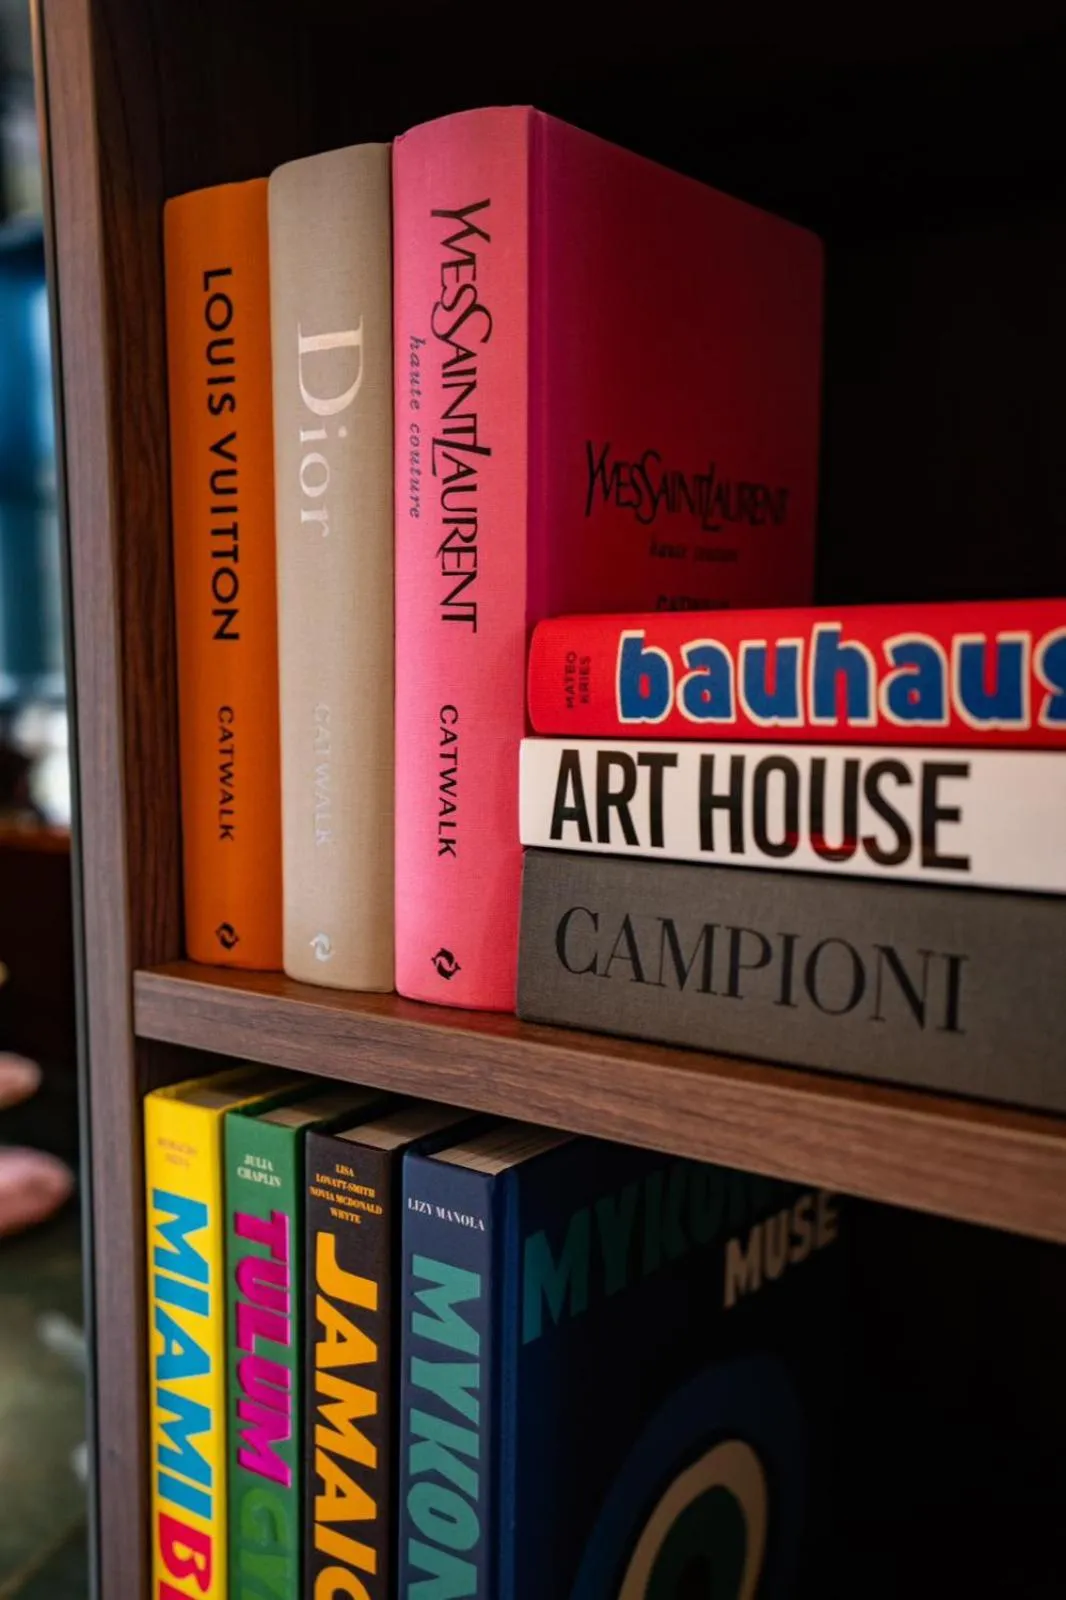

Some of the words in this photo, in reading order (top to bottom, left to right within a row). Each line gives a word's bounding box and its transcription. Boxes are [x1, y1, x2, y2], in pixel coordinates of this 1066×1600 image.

[203, 266, 235, 416] LOUIS
[409, 335, 426, 411] haute
[297, 314, 364, 538] Dior
[409, 422, 422, 519] couture
[209, 432, 240, 641] VUITTON
[565, 651, 577, 709] MATEO
[217, 705, 235, 842] CATWALK
[314, 704, 332, 847] CATWALK
[437, 704, 459, 858] CATWALK
[549, 749, 678, 848] ART
[698, 754, 971, 872] HOUSE
[555, 906, 969, 1035] CAMPIONI
[237, 1166, 282, 1188] CHAPLIN
[244, 1154, 274, 1172] JULIA
[336, 1164, 355, 1177] LISA
[407, 1197, 432, 1215] LIZY
[436, 1206, 485, 1231] MANOLA
[724, 1190, 840, 1310] MUSE
[152, 1188, 213, 1520] MIAMI
[233, 1209, 292, 1488] TULUM
